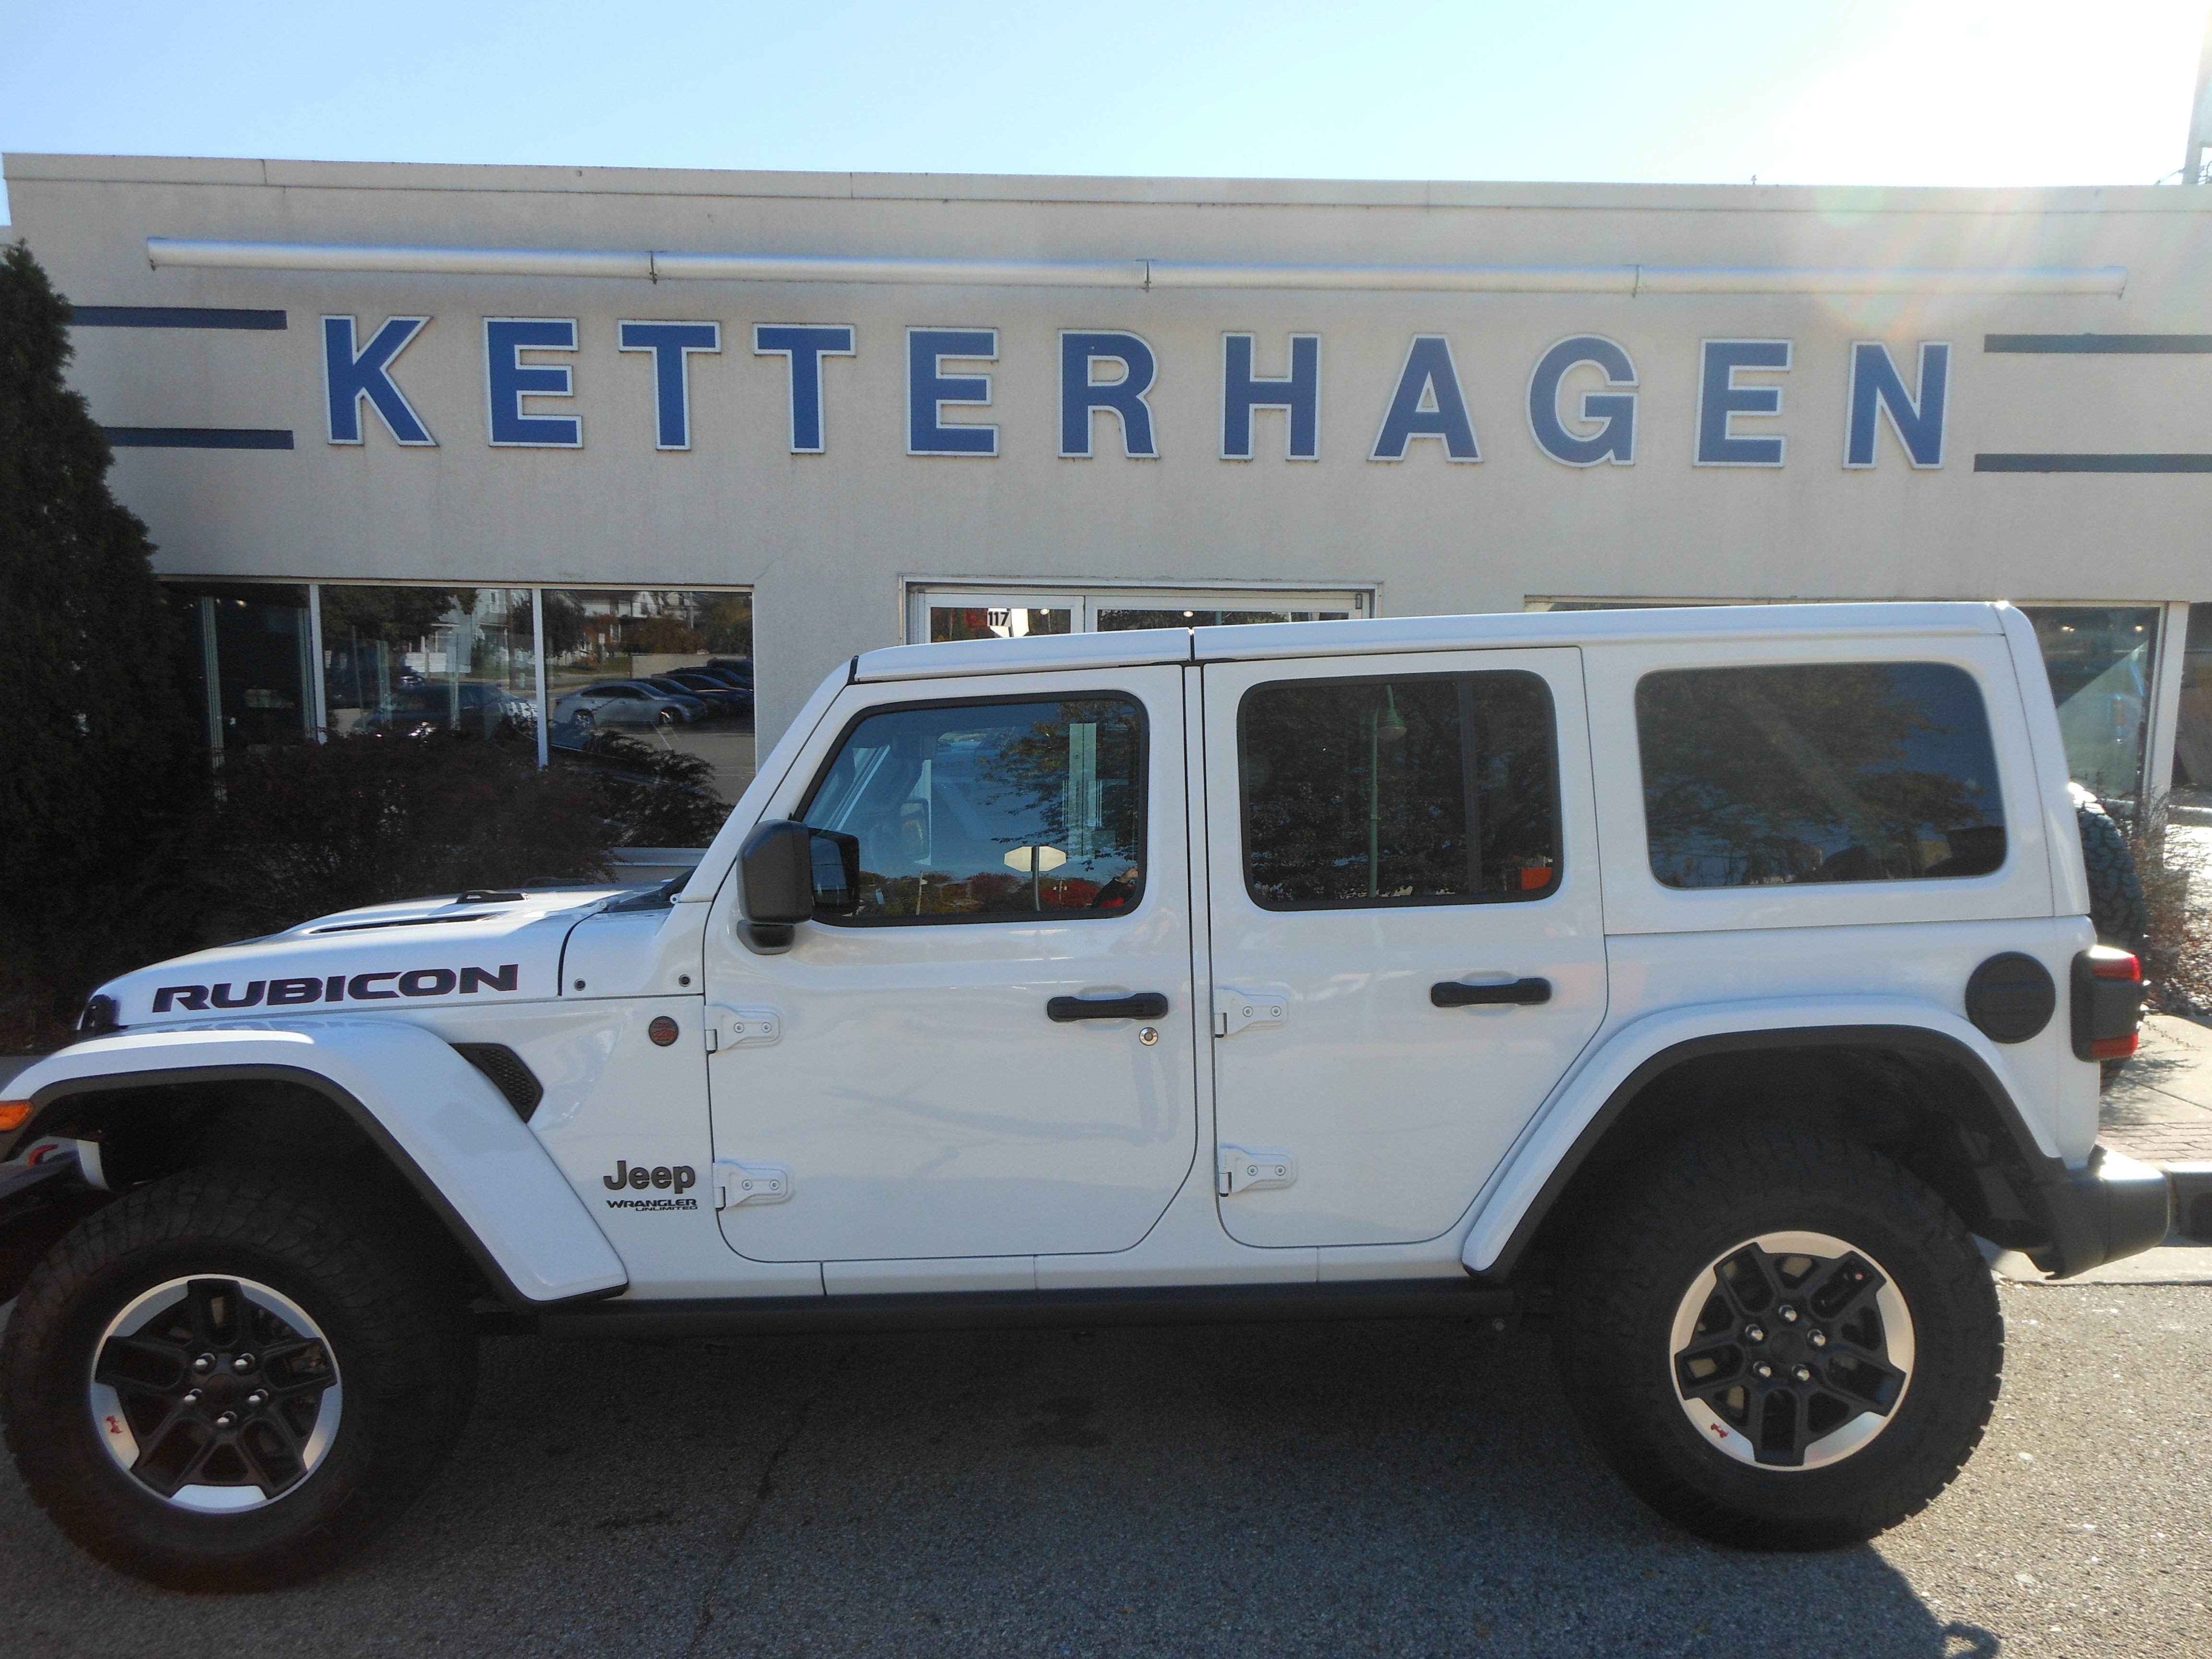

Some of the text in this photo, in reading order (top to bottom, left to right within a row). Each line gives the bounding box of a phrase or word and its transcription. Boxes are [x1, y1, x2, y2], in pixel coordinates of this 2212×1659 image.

[320, 314, 1953, 470] KETTERHAGEN
[988, 611, 1010, 626] 117
[152, 964, 518, 1013] RUBICON
[603, 1160, 696, 1194] Jeep
[606, 1199, 697, 1208] WRANGLER
